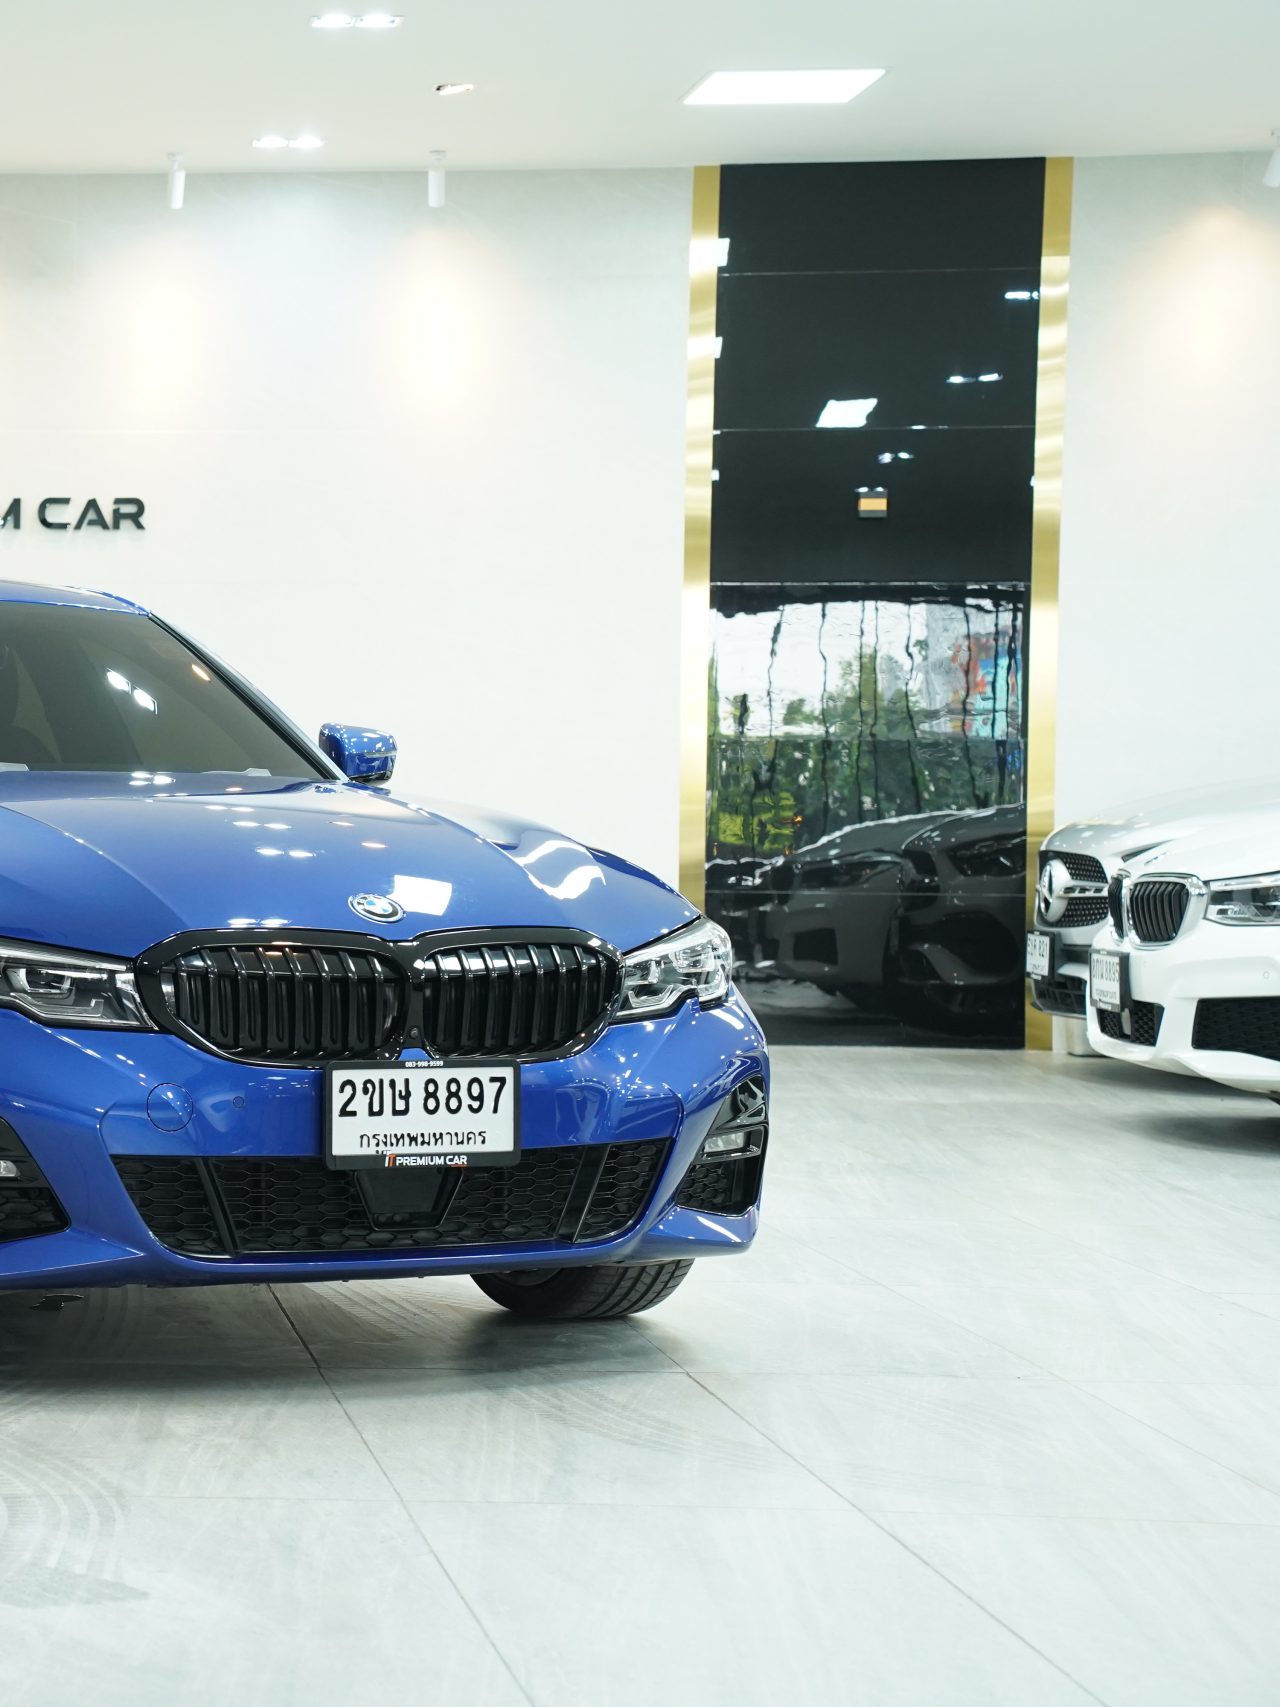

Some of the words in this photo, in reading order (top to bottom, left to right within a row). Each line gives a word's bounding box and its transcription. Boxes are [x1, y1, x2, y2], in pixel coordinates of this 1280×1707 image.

[37, 497, 146, 530] CAR
[338, 1077, 412, 1117] 2ขษ
[423, 1076, 507, 1116] 8897
[359, 1130, 487, 1148] กรุงเทพมหานคร
[396, 1156, 444, 1167] PREMIUM
[446, 1155, 468, 1165] CAR
